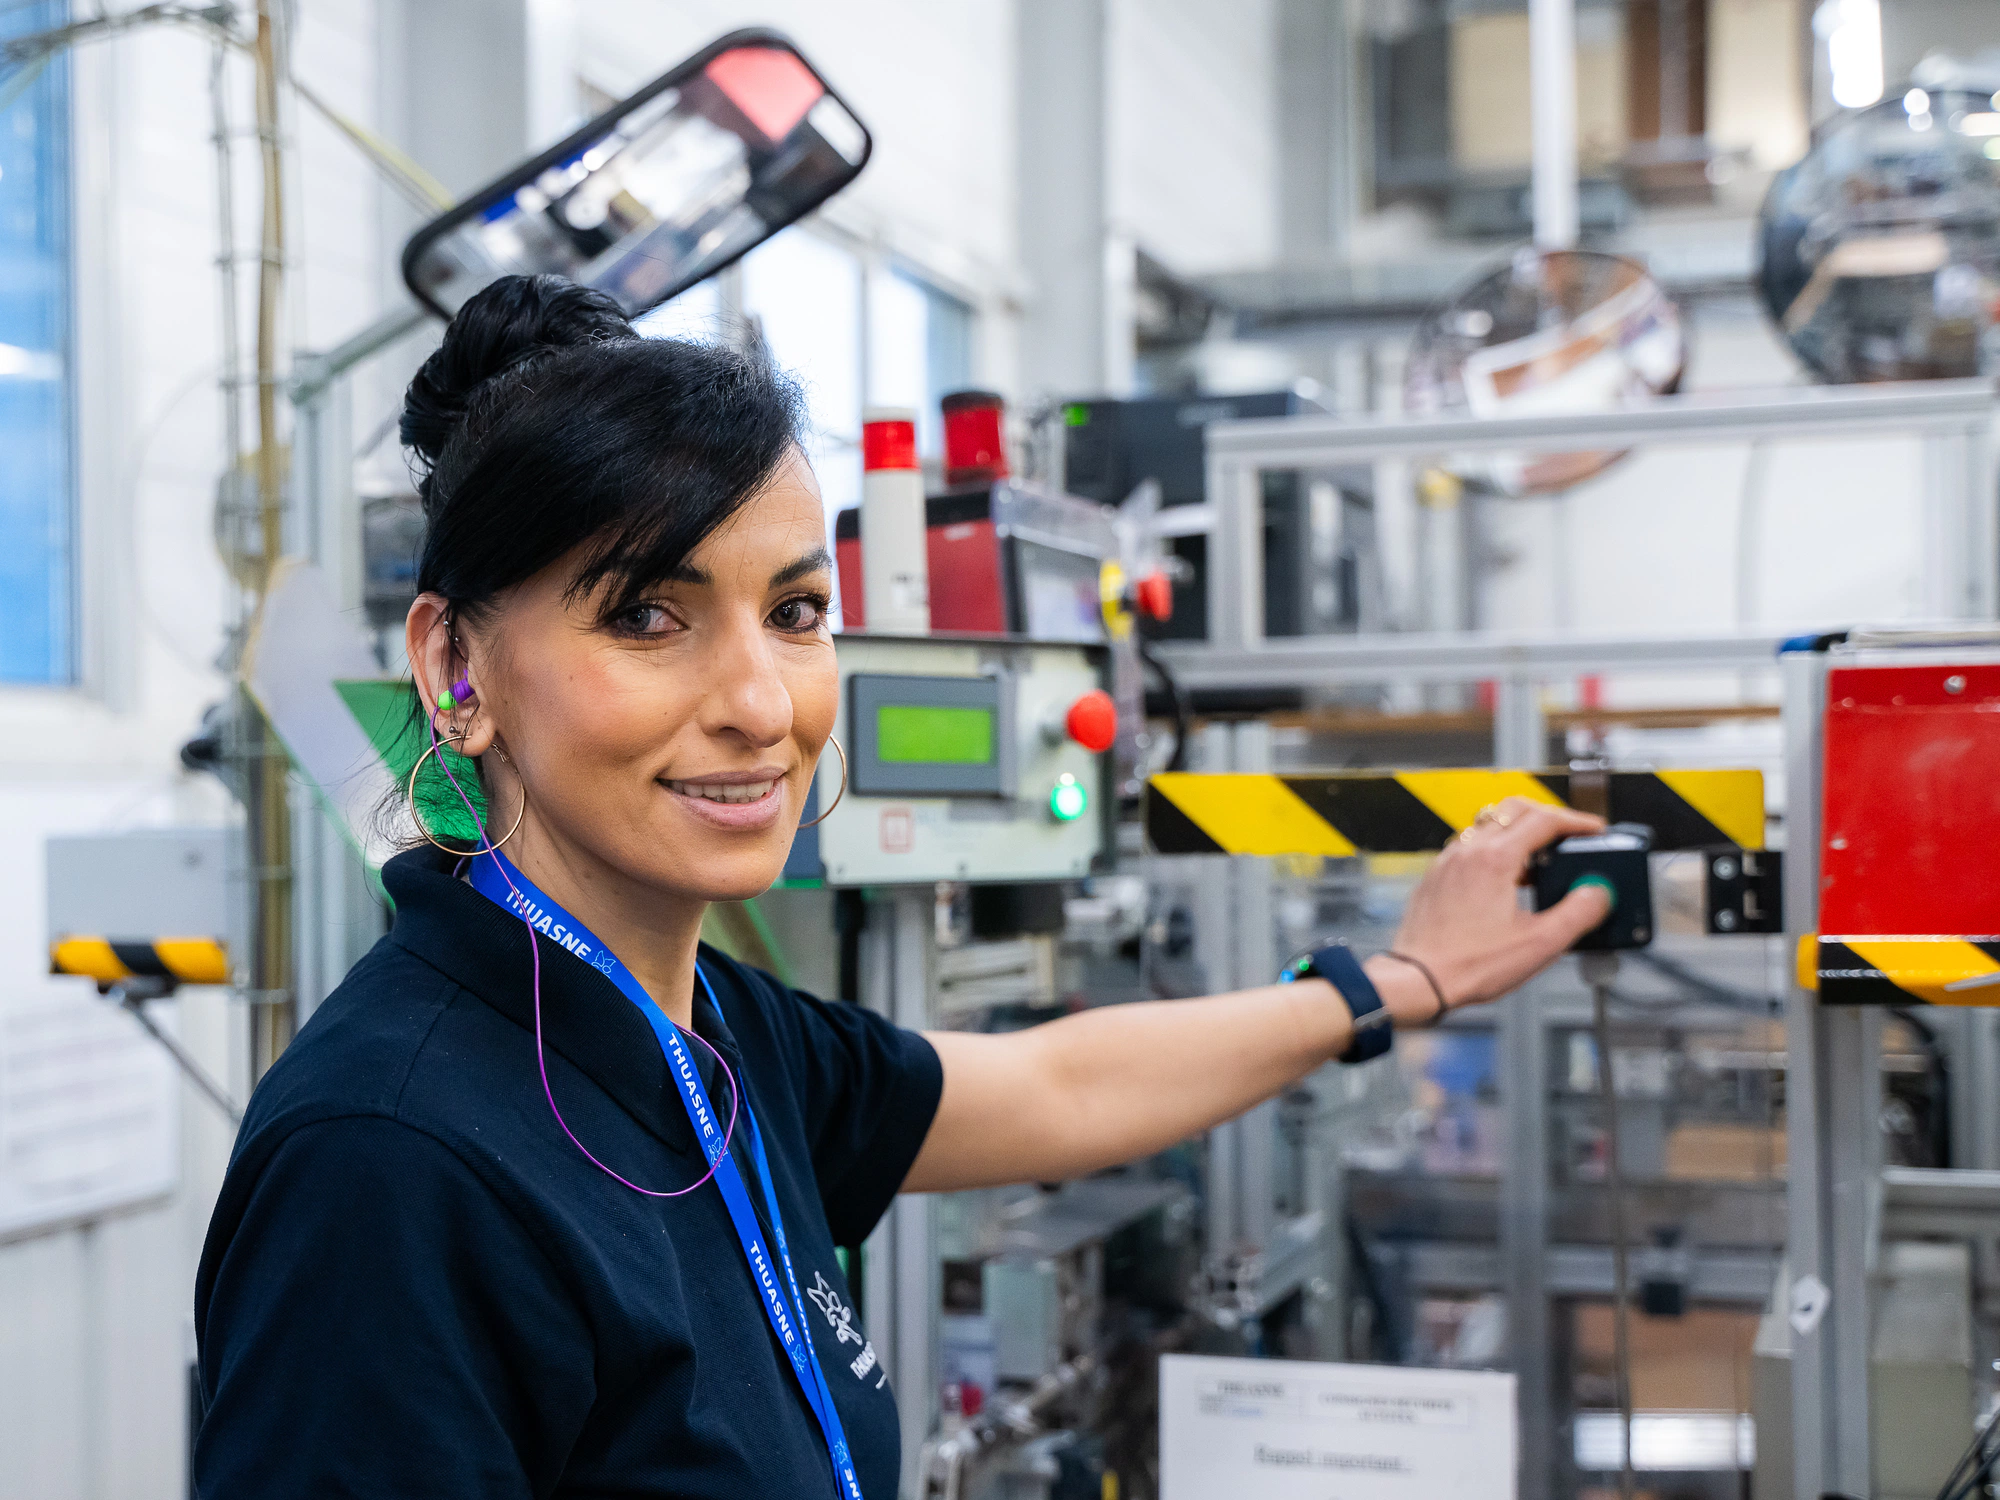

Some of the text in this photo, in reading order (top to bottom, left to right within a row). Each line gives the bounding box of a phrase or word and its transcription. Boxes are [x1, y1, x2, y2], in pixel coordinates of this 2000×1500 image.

[506, 886, 592, 960] THUASNE
[668, 1033, 714, 1138] THUASNE
[750, 1240, 794, 1345] THUASNE
